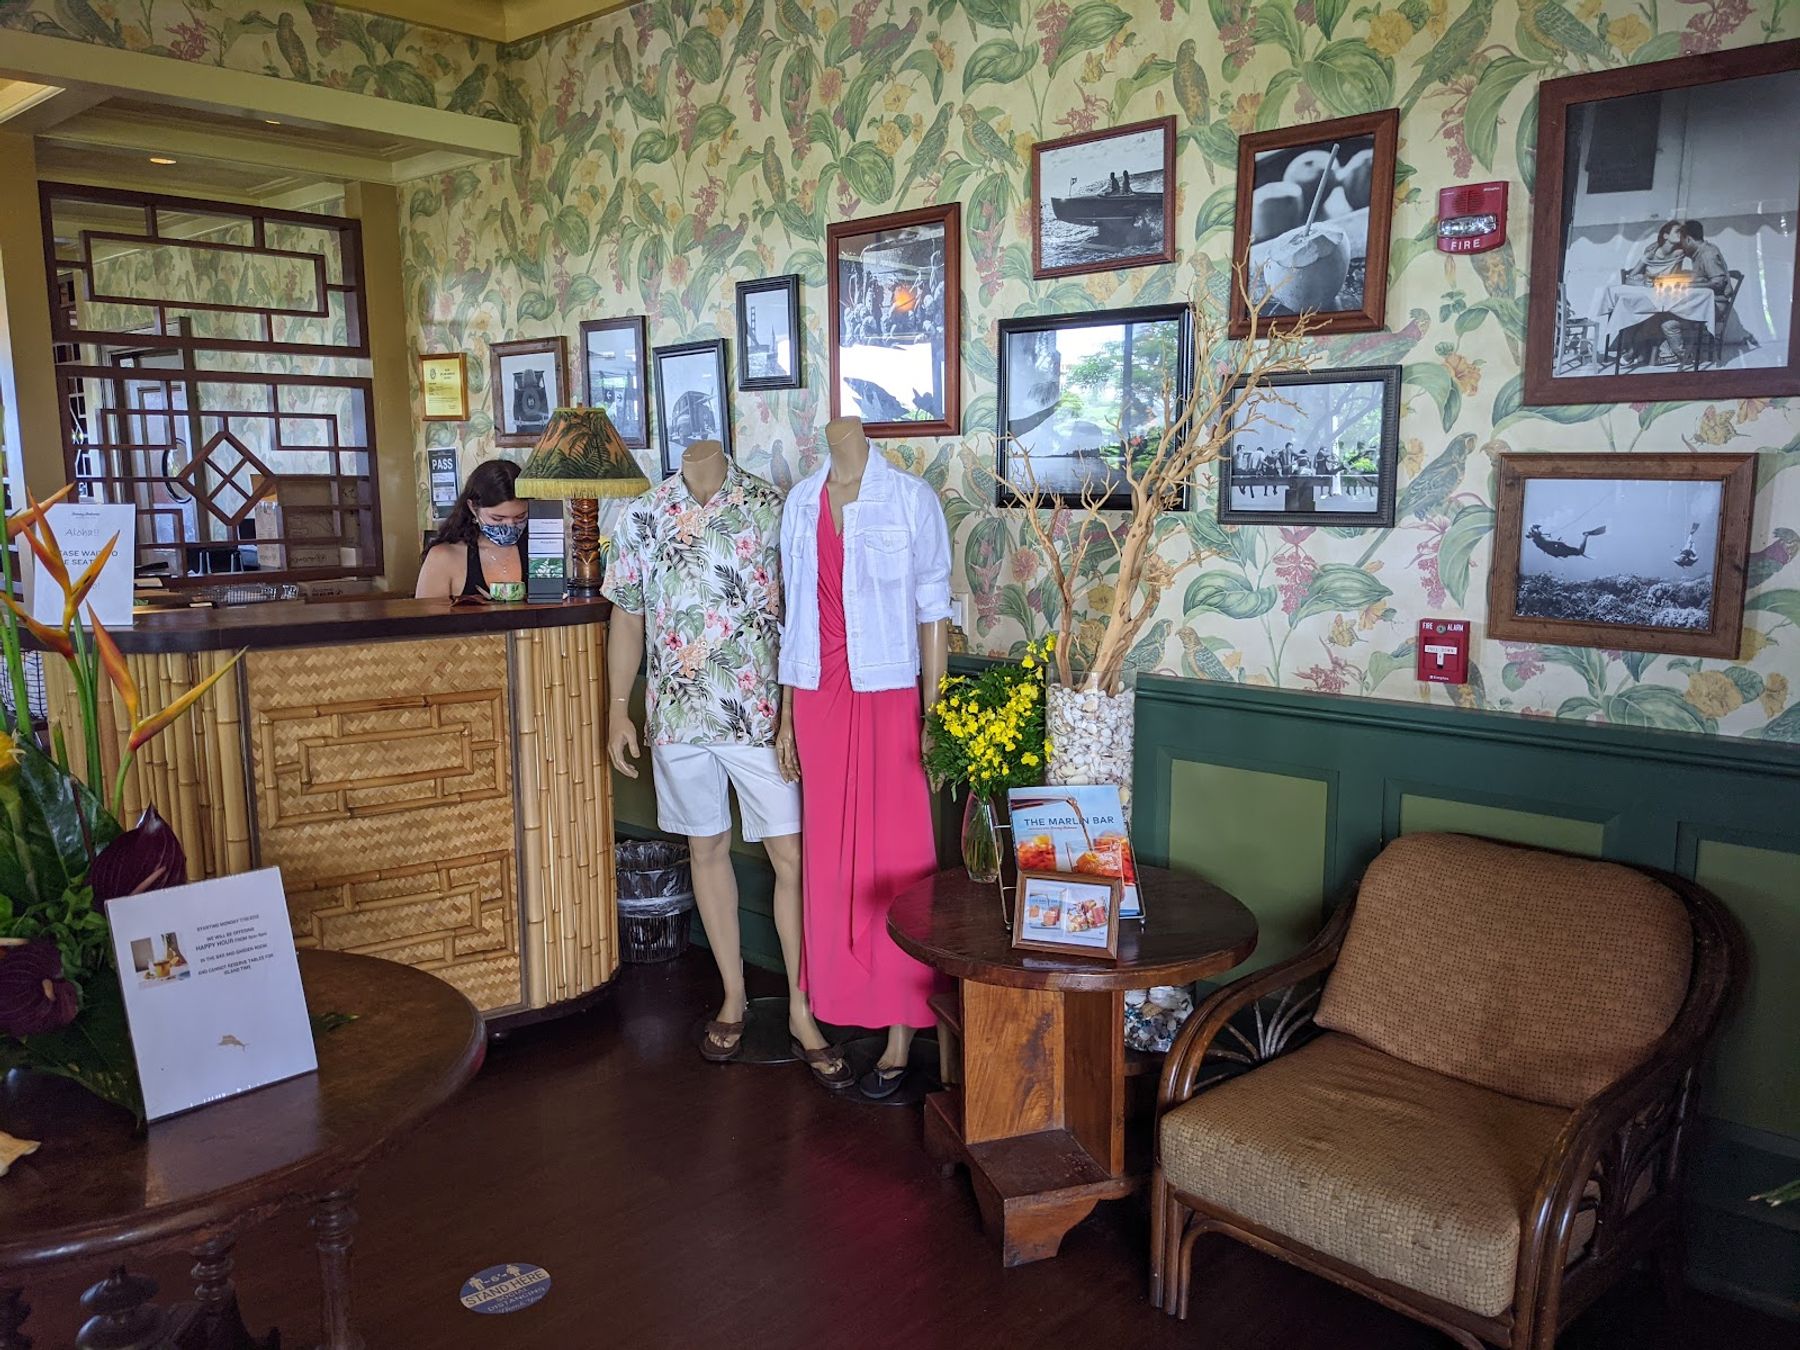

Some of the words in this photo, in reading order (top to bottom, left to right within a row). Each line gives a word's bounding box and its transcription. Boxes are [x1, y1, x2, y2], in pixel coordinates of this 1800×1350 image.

[1450, 239, 1481, 250] FIRE
[432, 458, 453, 470] PASS
[1422, 622, 1433, 630] FIRE
[1447, 624, 1464, 632] ALARM
[1024, 818, 1045, 826] THE
[1048, 816, 1089, 826] MARLN
[1093, 815, 1114, 825] BAR
[195, 942, 215, 951] HAPPY
[217, 938, 234, 947] HOUR
[466, 1284, 510, 1306] STAND
[510, 1270, 545, 1287] HERE
[495, 1287, 530, 1301] SOCIAL
[487, 1287, 545, 1312] DISTANCING
